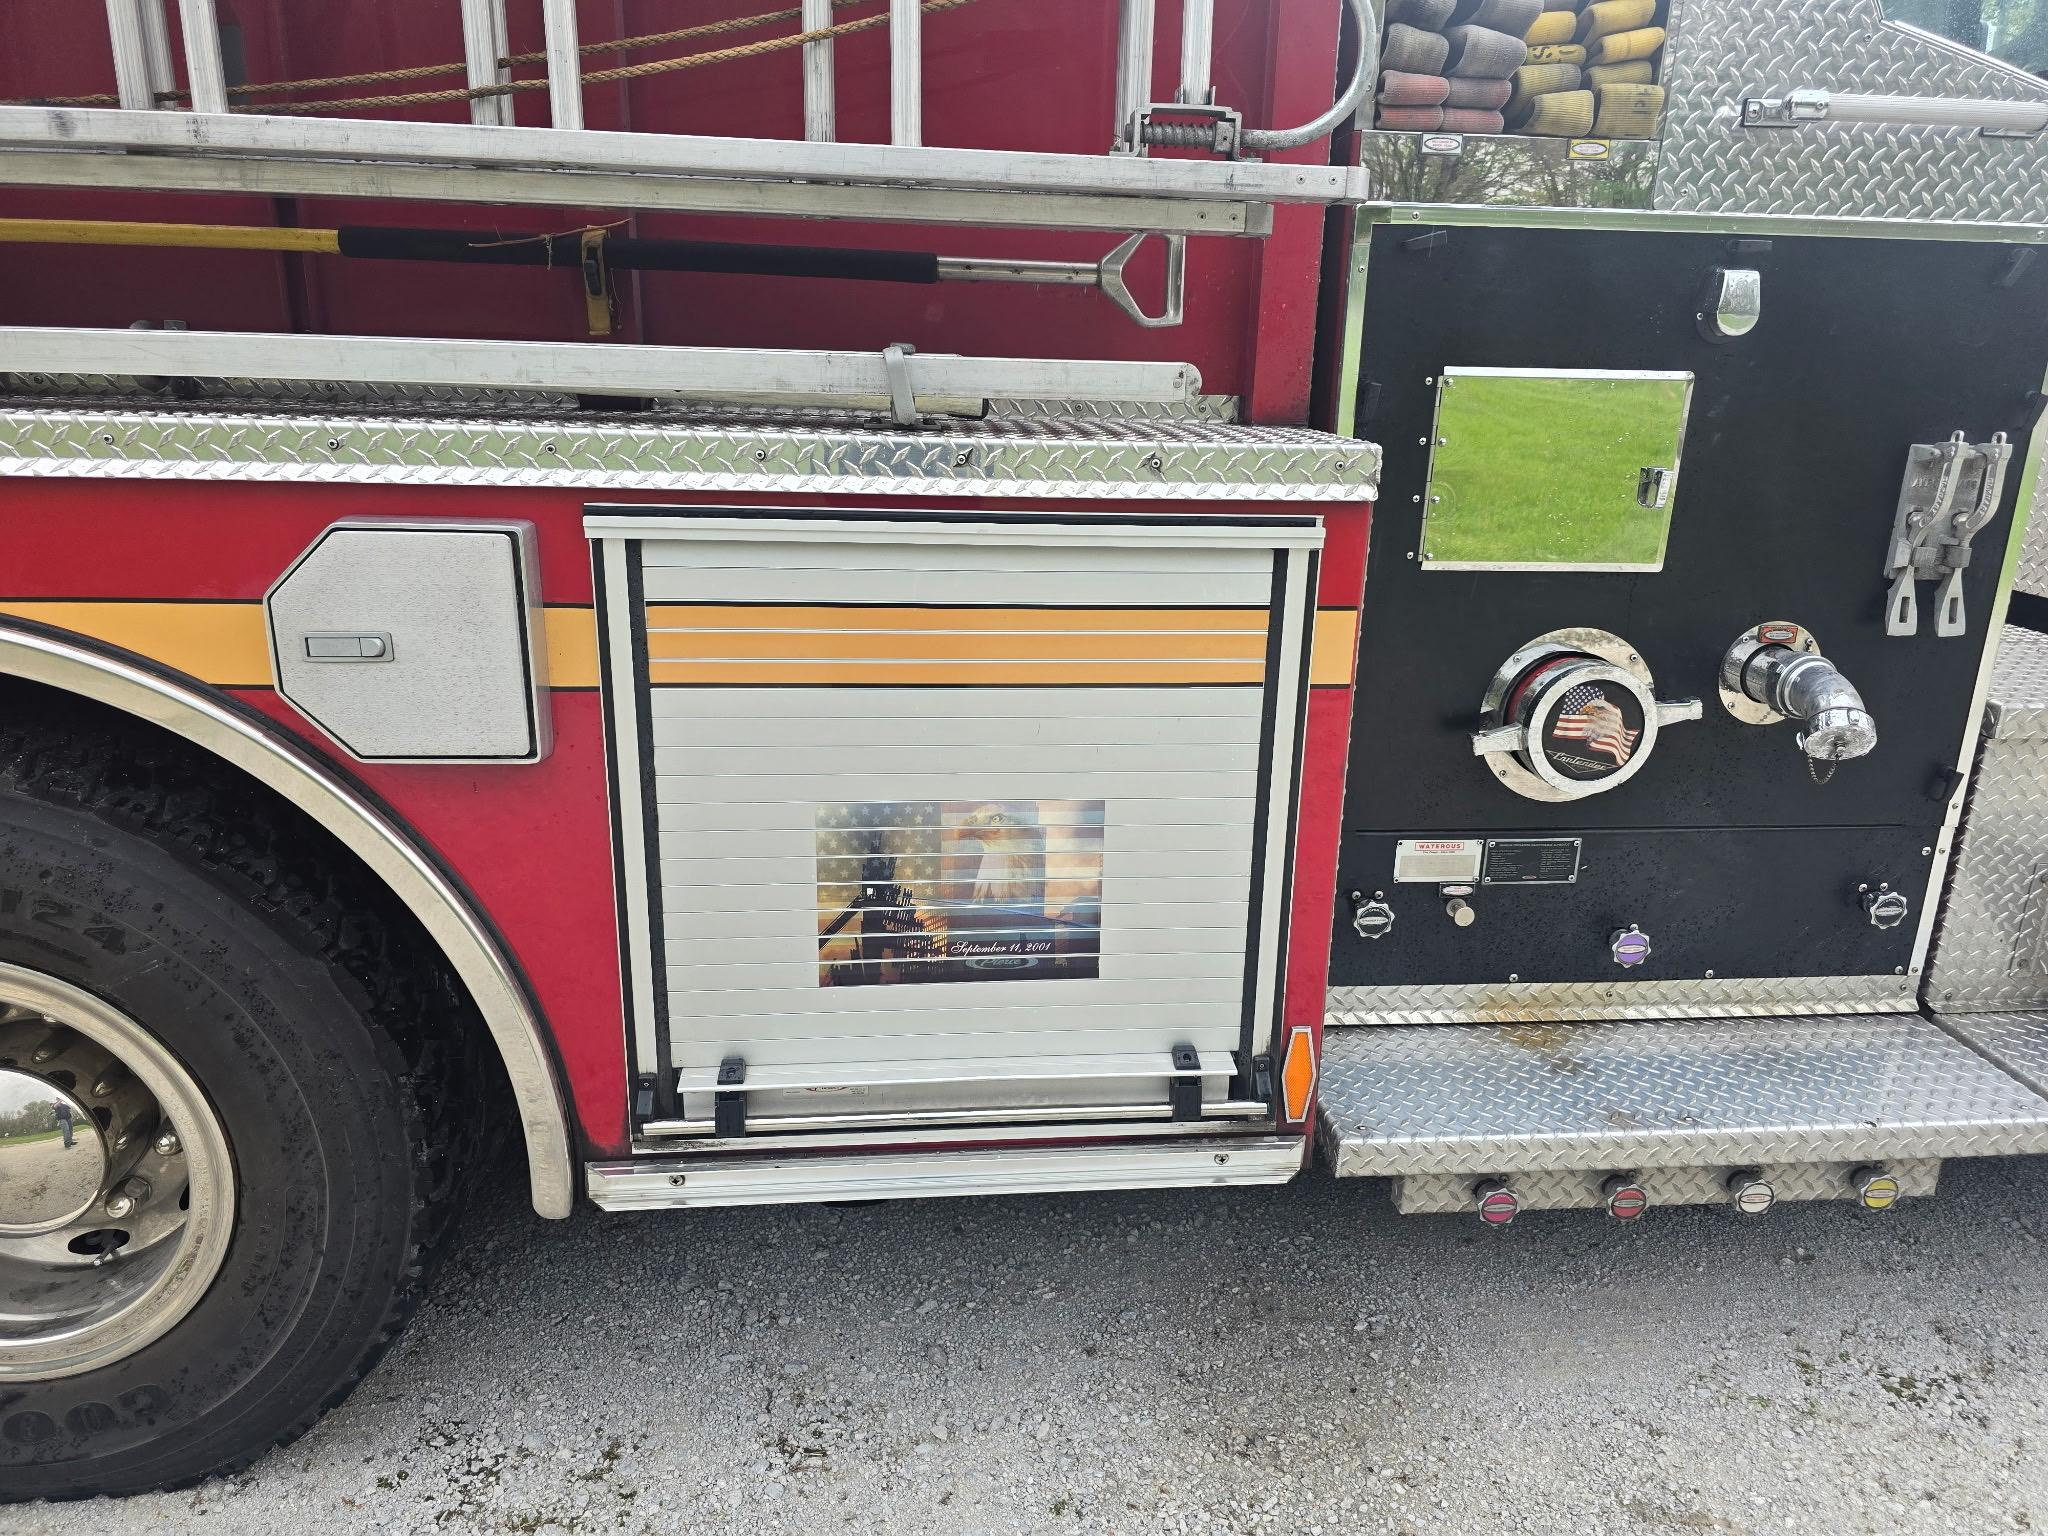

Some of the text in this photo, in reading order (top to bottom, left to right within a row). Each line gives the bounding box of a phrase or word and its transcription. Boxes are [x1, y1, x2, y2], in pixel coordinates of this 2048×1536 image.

[950, 940, 1051, 956] September 11, 2001
